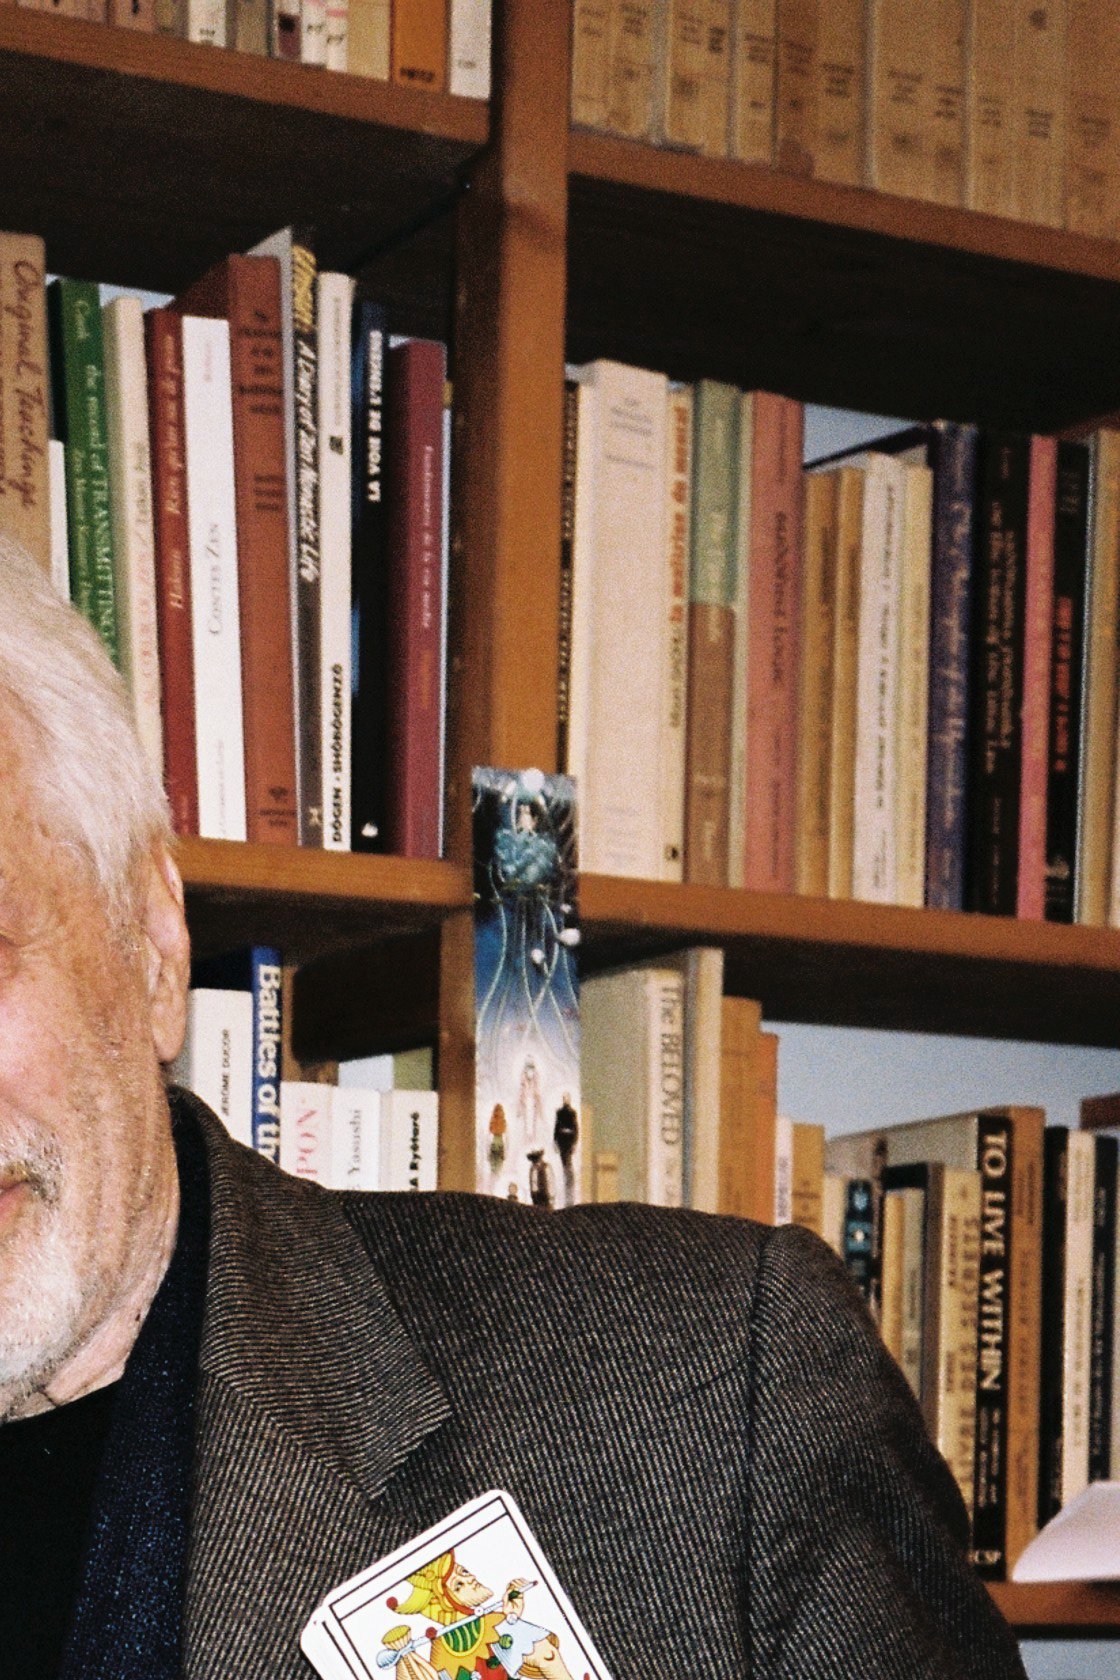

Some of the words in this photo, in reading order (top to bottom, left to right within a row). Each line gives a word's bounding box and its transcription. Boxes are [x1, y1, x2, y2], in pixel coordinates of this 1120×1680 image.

[367, 436, 383, 475] VOIE
[367, 481, 383, 502] LA
[257, 963, 281, 1079] Battles
[257, 1083, 282, 1115] of
[982, 1132, 1007, 1177] TO
[981, 1190, 1005, 1257] LIVE
[979, 1269, 1004, 1392] WITHIN
